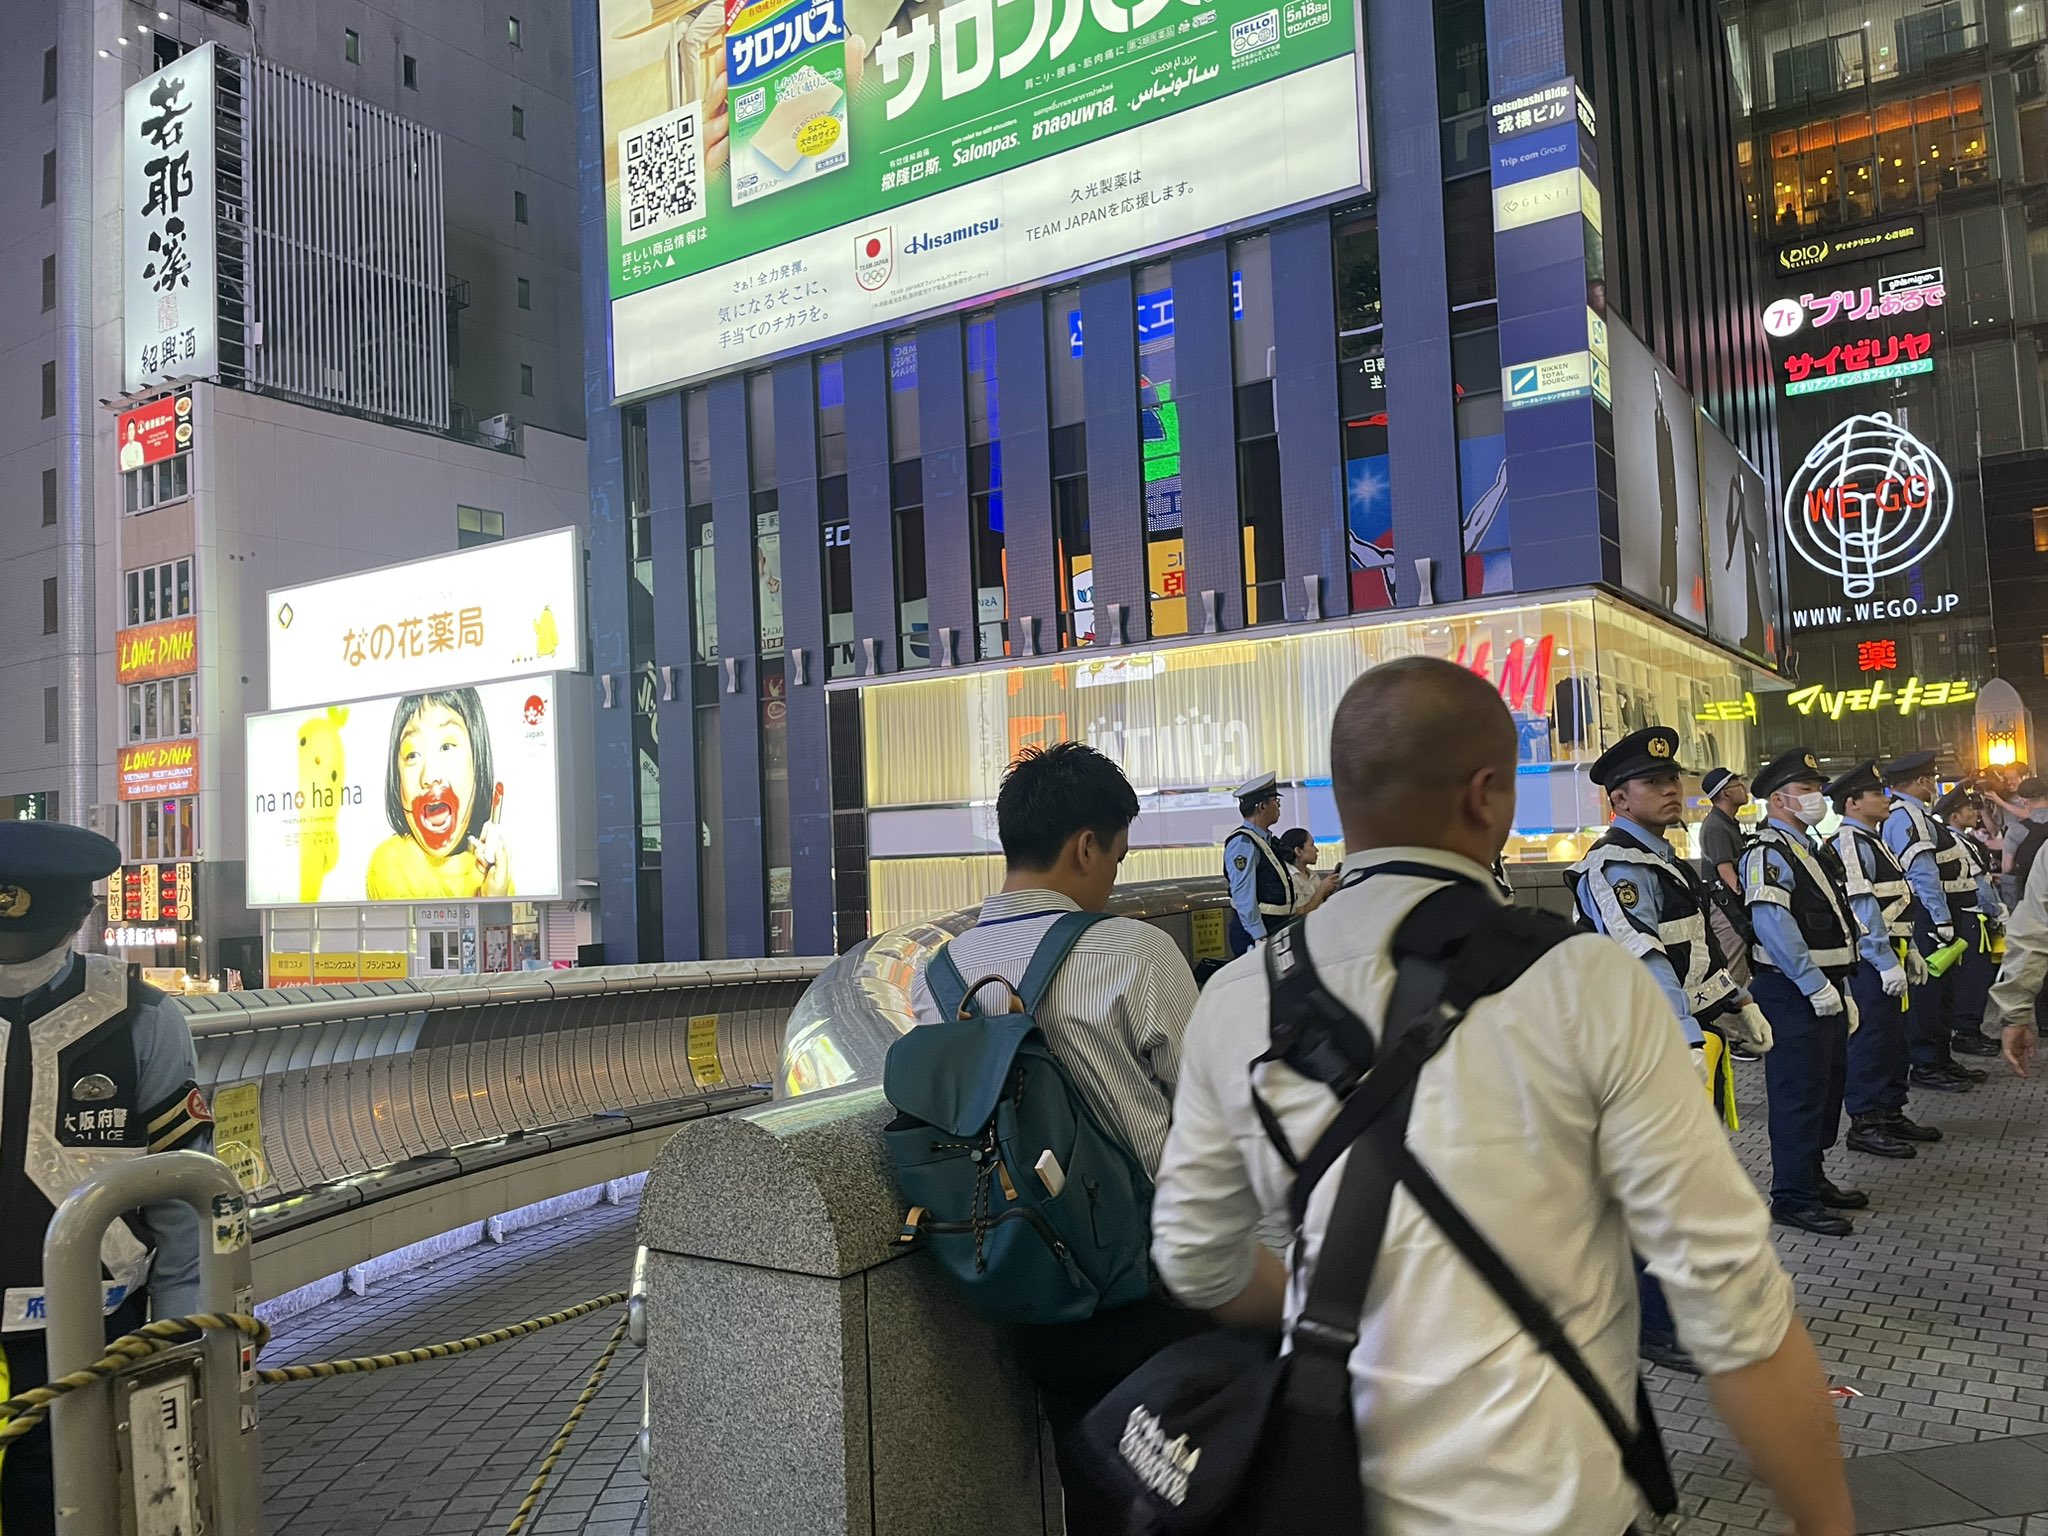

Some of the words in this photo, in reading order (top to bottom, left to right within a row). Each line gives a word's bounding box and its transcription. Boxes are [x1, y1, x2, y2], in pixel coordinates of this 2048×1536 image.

[733, 1, 839, 76] サロンパス
[1236, 16, 1274, 37] HELLO!
[1492, 91, 1544, 117] Ebisubashi
[1544, 85, 1570, 101] Bldg.
[1497, 102, 1566, 134] 戎橋ビル
[952, 132, 1018, 168] Salonpas
[1540, 144, 1567, 157] Group
[1070, 169, 1142, 204] 久光製薬は
[1026, 220, 1061, 242] TEAM
[1064, 181, 1195, 231] JAPANを応援します。
[622, 226, 708, 267] 詳しい商品情報は
[904, 217, 1000, 255] Hisamitsu
[859, 262, 873, 272] TEAM
[873, 258, 889, 268] JAPAN
[1789, 244, 1820, 262] DIO
[1790, 257, 1820, 269] CLINIC
[622, 259, 663, 281] こちらへ
[757, 259, 809, 287] 全力発揮。
[718, 281, 828, 326] 気になるそこに、
[1772, 309, 1796, 330] 7F
[718, 305, 829, 349] 手当てのチカラを。
[1541, 363, 1569, 374] NIKKEN
[1784, 332, 1932, 382] サイゼリヤ
[1542, 371, 1565, 379] TOTAL
[1542, 374, 1580, 387] SOURCING
[1793, 593, 1960, 628] WWW.WEGO.JP
[121, 637, 156, 672] LONG
[159, 630, 195, 665] DINH
[342, 606, 484, 667] なの花薬局
[1858, 640, 1897, 671] 薬
[1787, 677, 1976, 720] マツモトキヨシ
[123, 750, 156, 772] LONG
[158, 745, 193, 768] DINH
[178, 864, 191, 920] 串かつ
[366, 961, 402, 970] ブランドコスメ
[64, 1107, 128, 1132] 大阪府警
